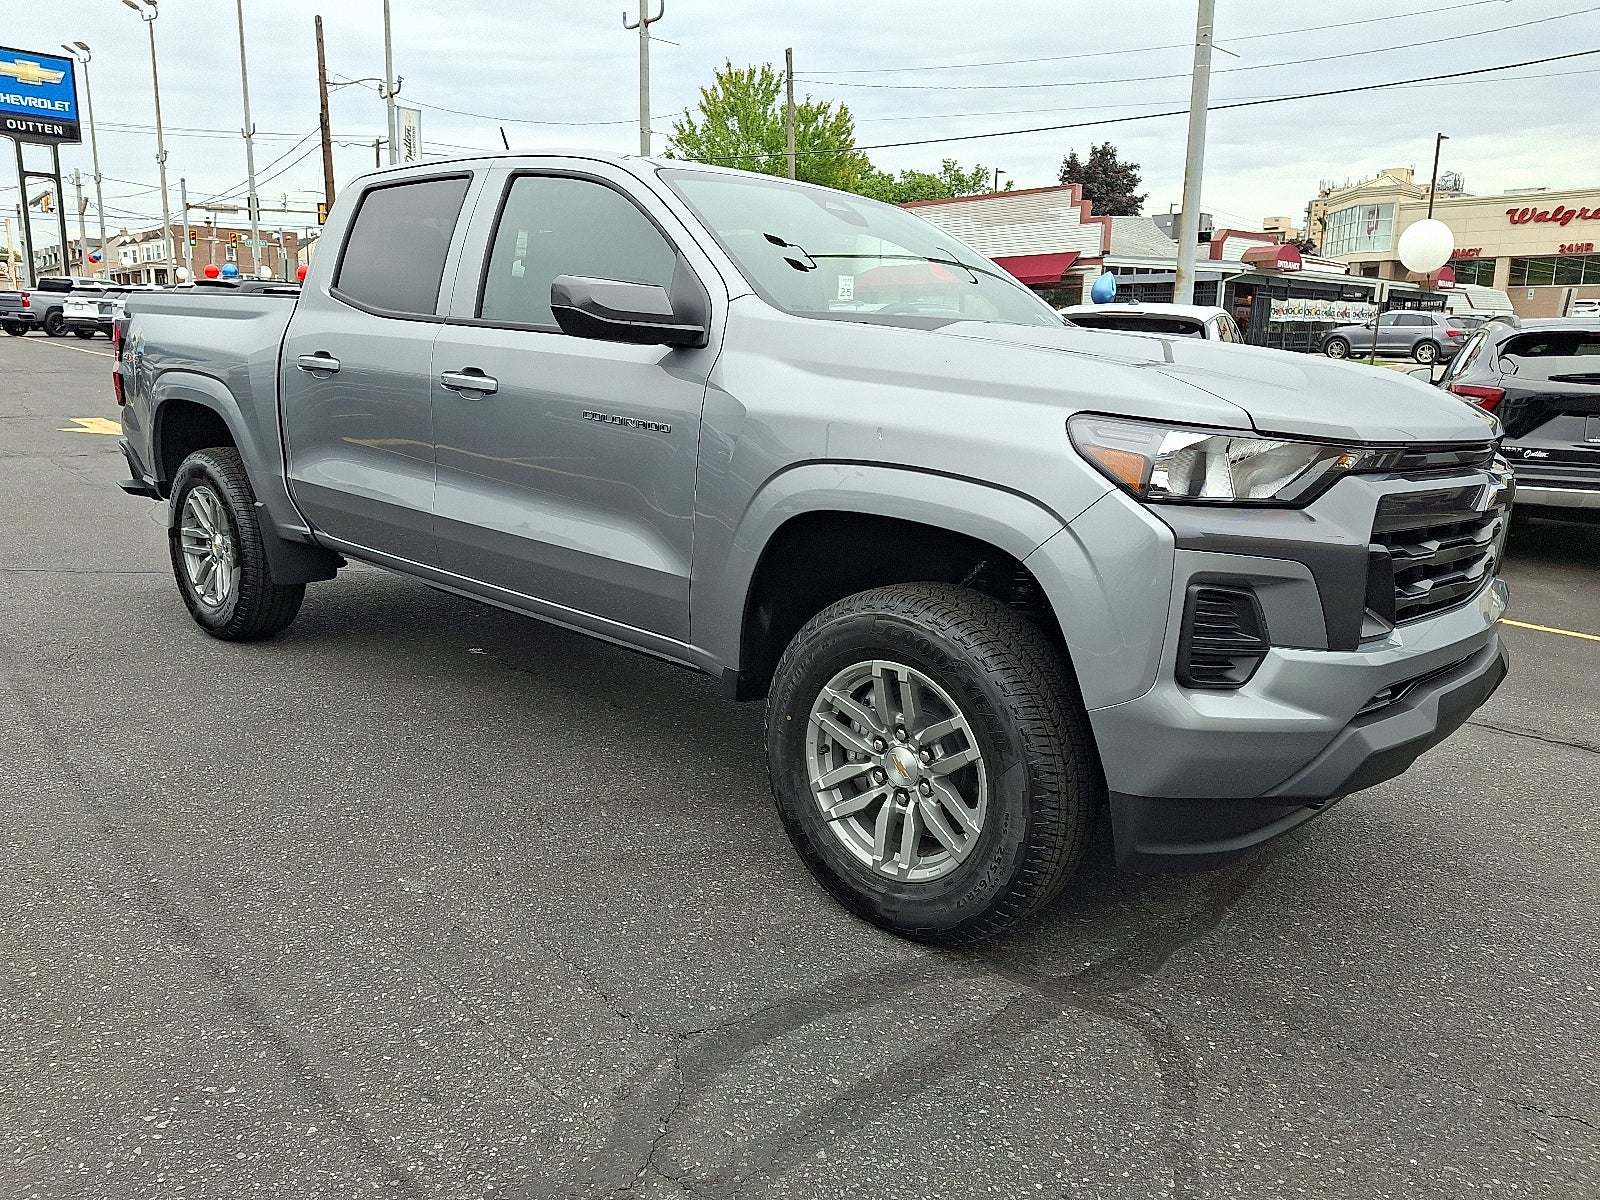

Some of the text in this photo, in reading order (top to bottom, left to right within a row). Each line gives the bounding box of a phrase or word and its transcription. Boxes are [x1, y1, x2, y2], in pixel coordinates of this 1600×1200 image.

[6, 119, 63, 135] OUTTEN
[1452, 248, 1482, 258] MACY
[840, 287, 852, 297] 25
[582, 410, 672, 434] COLORADO
